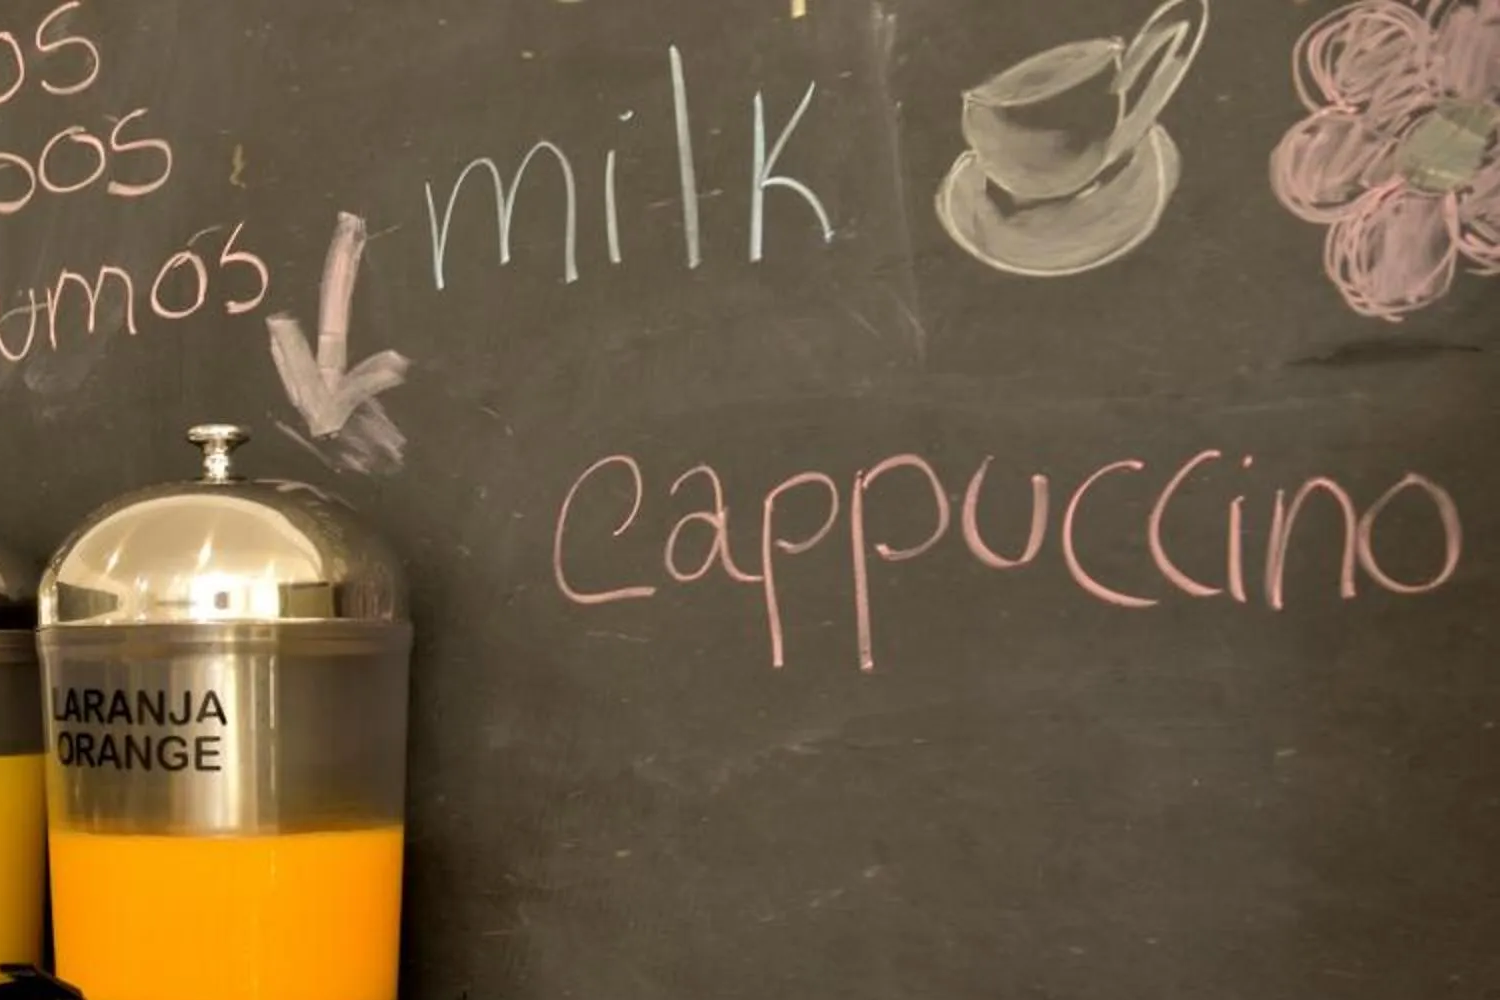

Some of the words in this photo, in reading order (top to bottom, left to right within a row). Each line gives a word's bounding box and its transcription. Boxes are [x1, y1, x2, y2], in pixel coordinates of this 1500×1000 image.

[424, 44, 835, 291] milk
[52, 687, 228, 726] LARANJA
[57, 730, 222, 772] ORANGE
